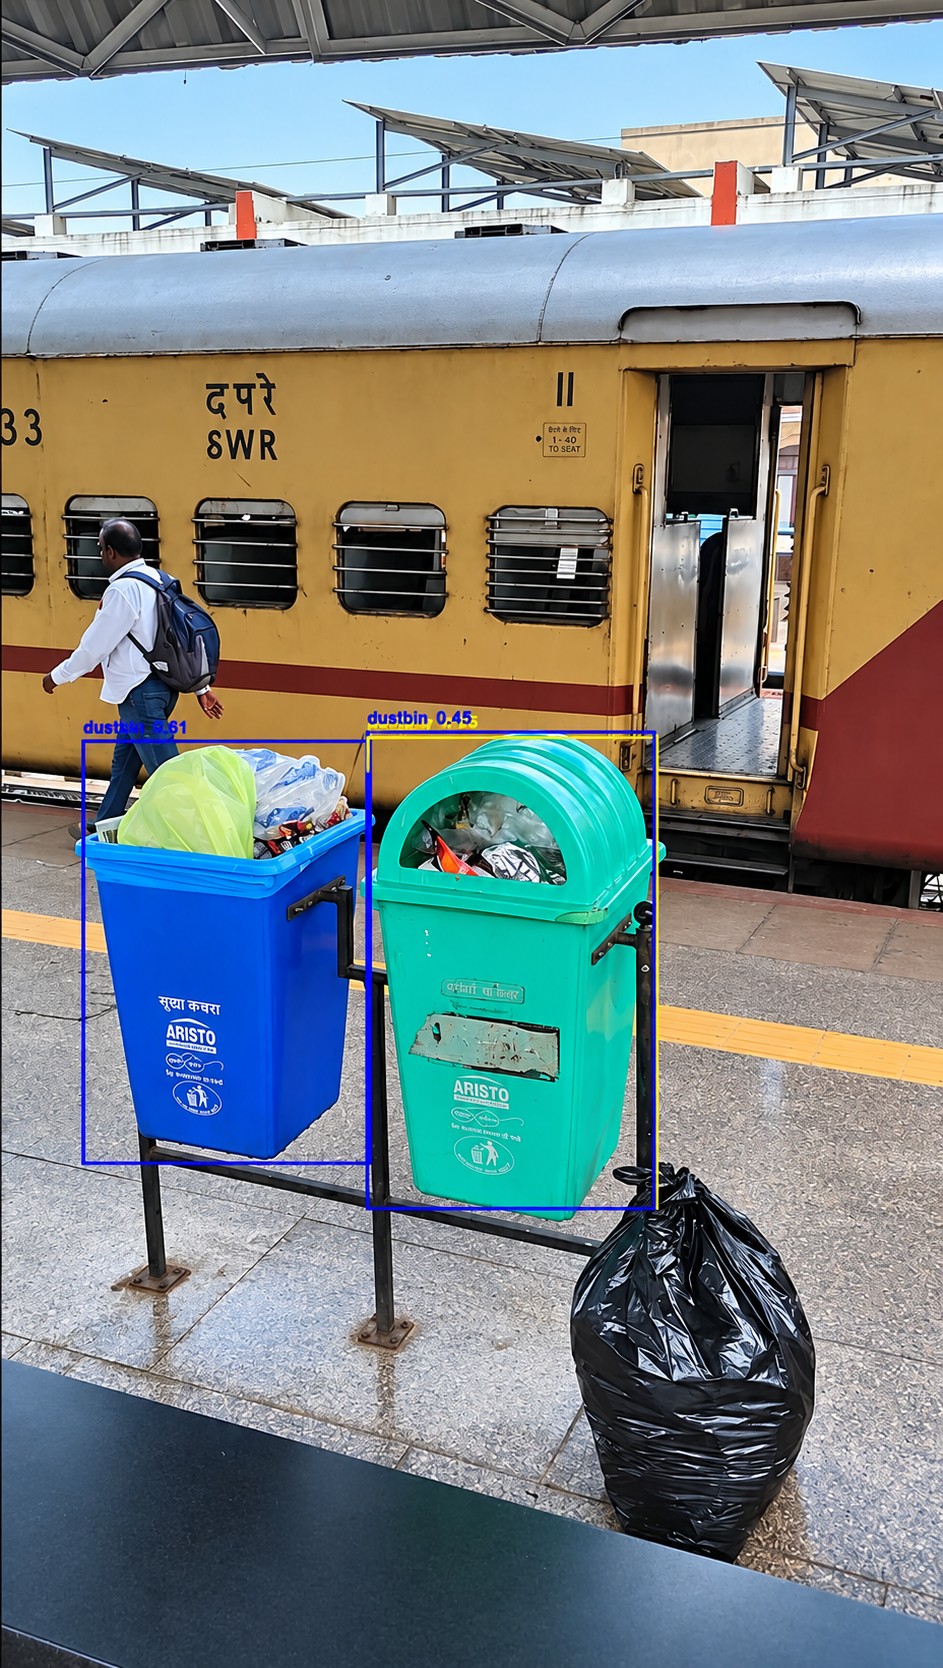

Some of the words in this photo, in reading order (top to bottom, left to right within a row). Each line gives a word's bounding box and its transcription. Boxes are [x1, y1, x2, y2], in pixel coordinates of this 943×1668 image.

[206, 429, 278, 461] SWR
[548, 445, 559, 453] TO
[561, 445, 581, 453] SEAT
[564, 436, 577, 444] 40
[166, 1024, 216, 1046] ARISTO
[453, 1079, 509, 1103] ARISTO
